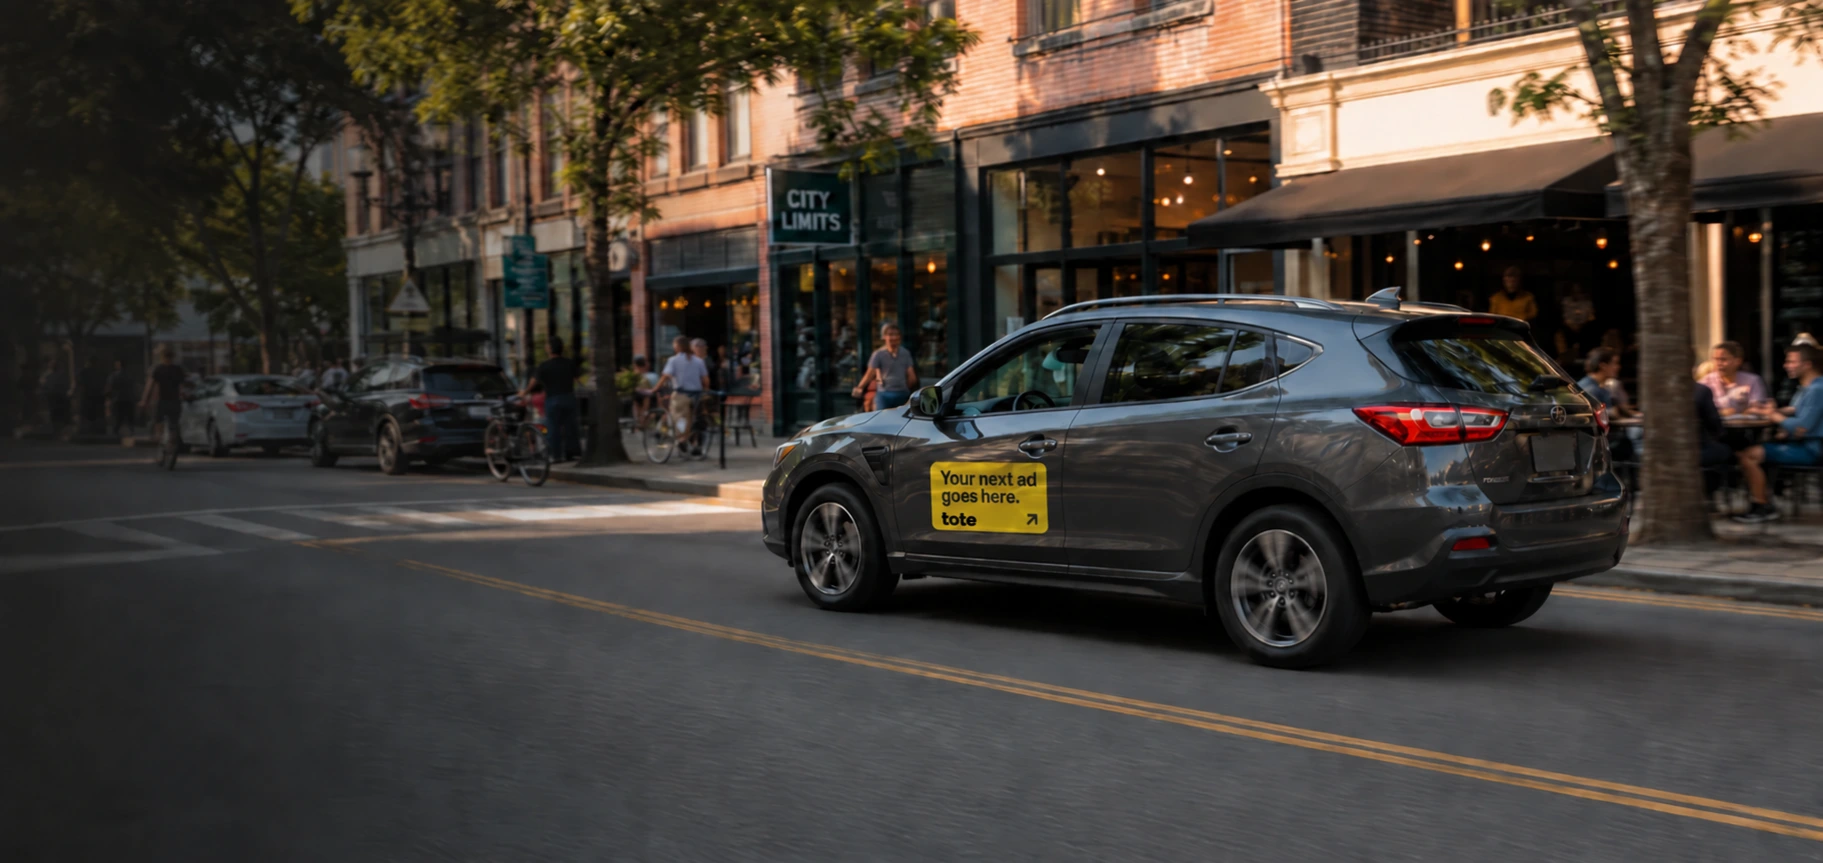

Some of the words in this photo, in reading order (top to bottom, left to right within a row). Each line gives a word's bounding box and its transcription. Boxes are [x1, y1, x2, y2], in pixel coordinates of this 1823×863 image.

[787, 189, 830, 209] CITY
[781, 211, 841, 231] LIMITS
[941, 470, 975, 486] Your
[979, 472, 1013, 486] next
[1017, 472, 1037, 487] ad
[941, 491, 978, 507] goes
[981, 488, 1020, 504] here.
[941, 512, 977, 526] tote
